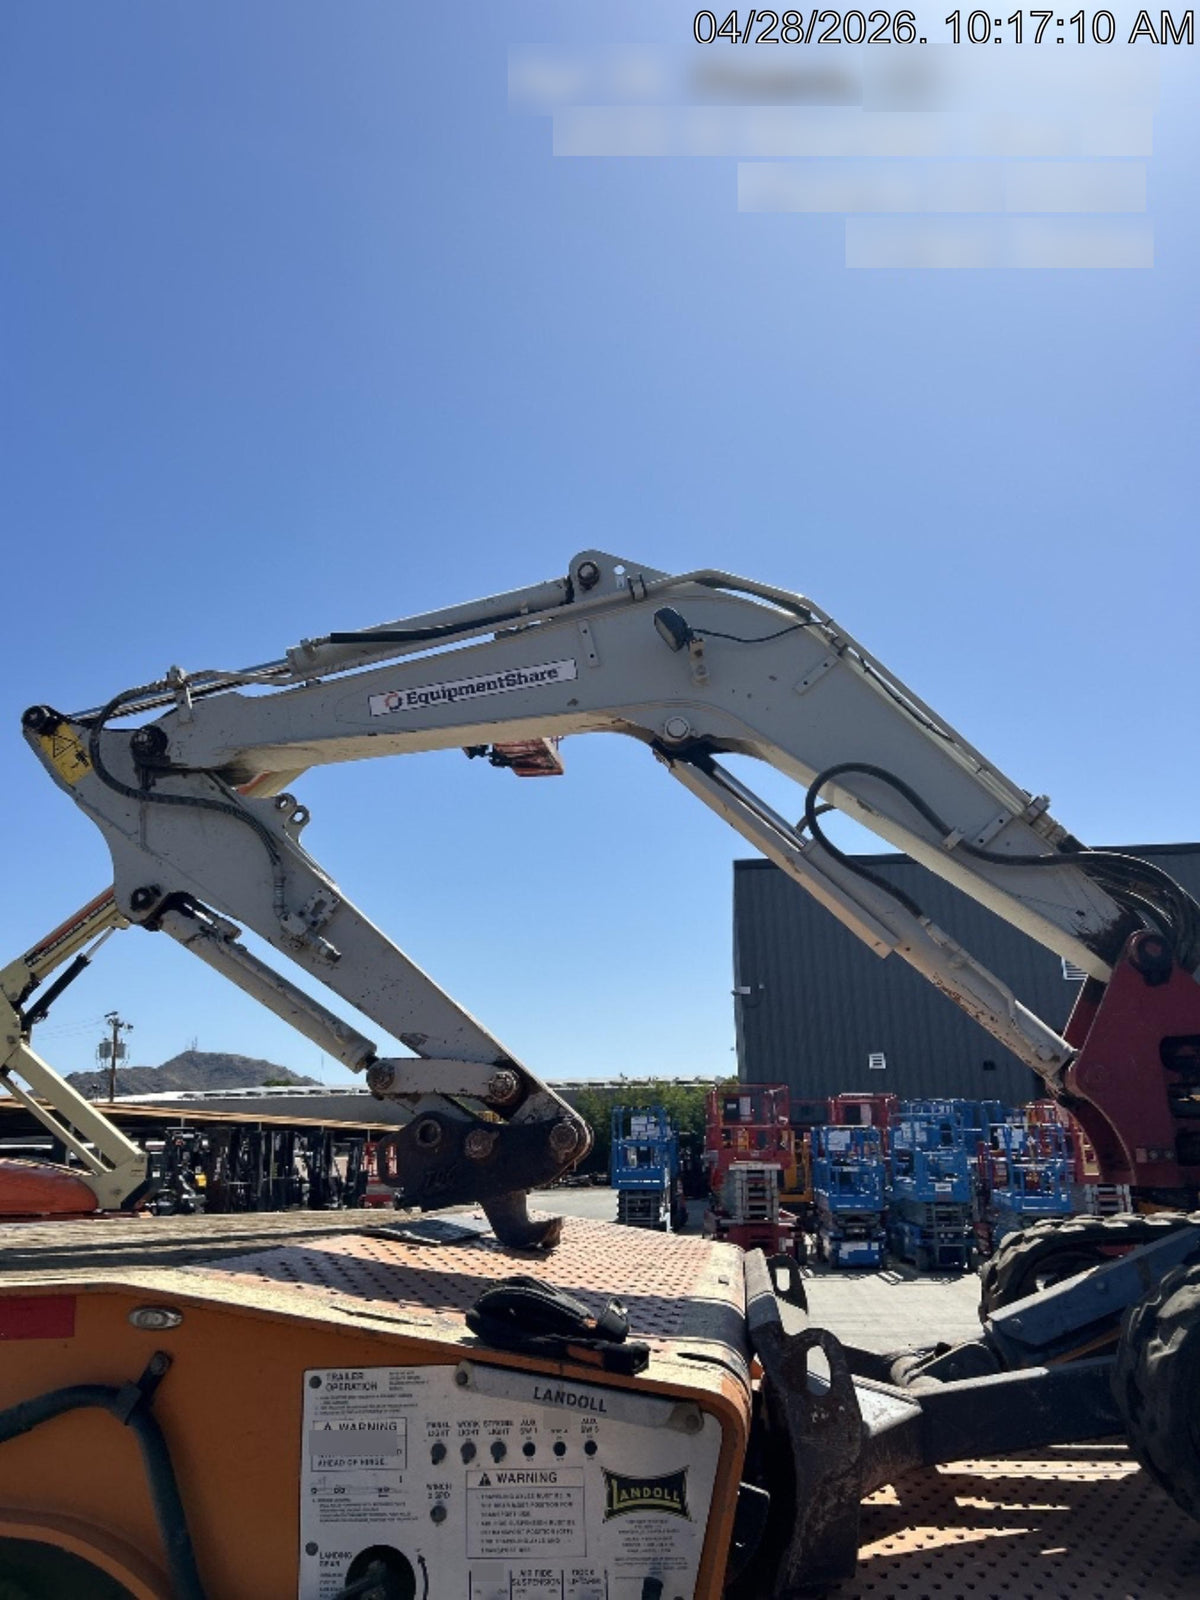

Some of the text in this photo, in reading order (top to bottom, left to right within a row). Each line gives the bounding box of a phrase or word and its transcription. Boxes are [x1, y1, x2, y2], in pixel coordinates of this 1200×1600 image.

[406, 667, 559, 706] EquipmentShare
[533, 1386, 608, 1413] LANDOLL
[496, 1471, 558, 1484] WARNING
[612, 1479, 682, 1510] LANDOLL
